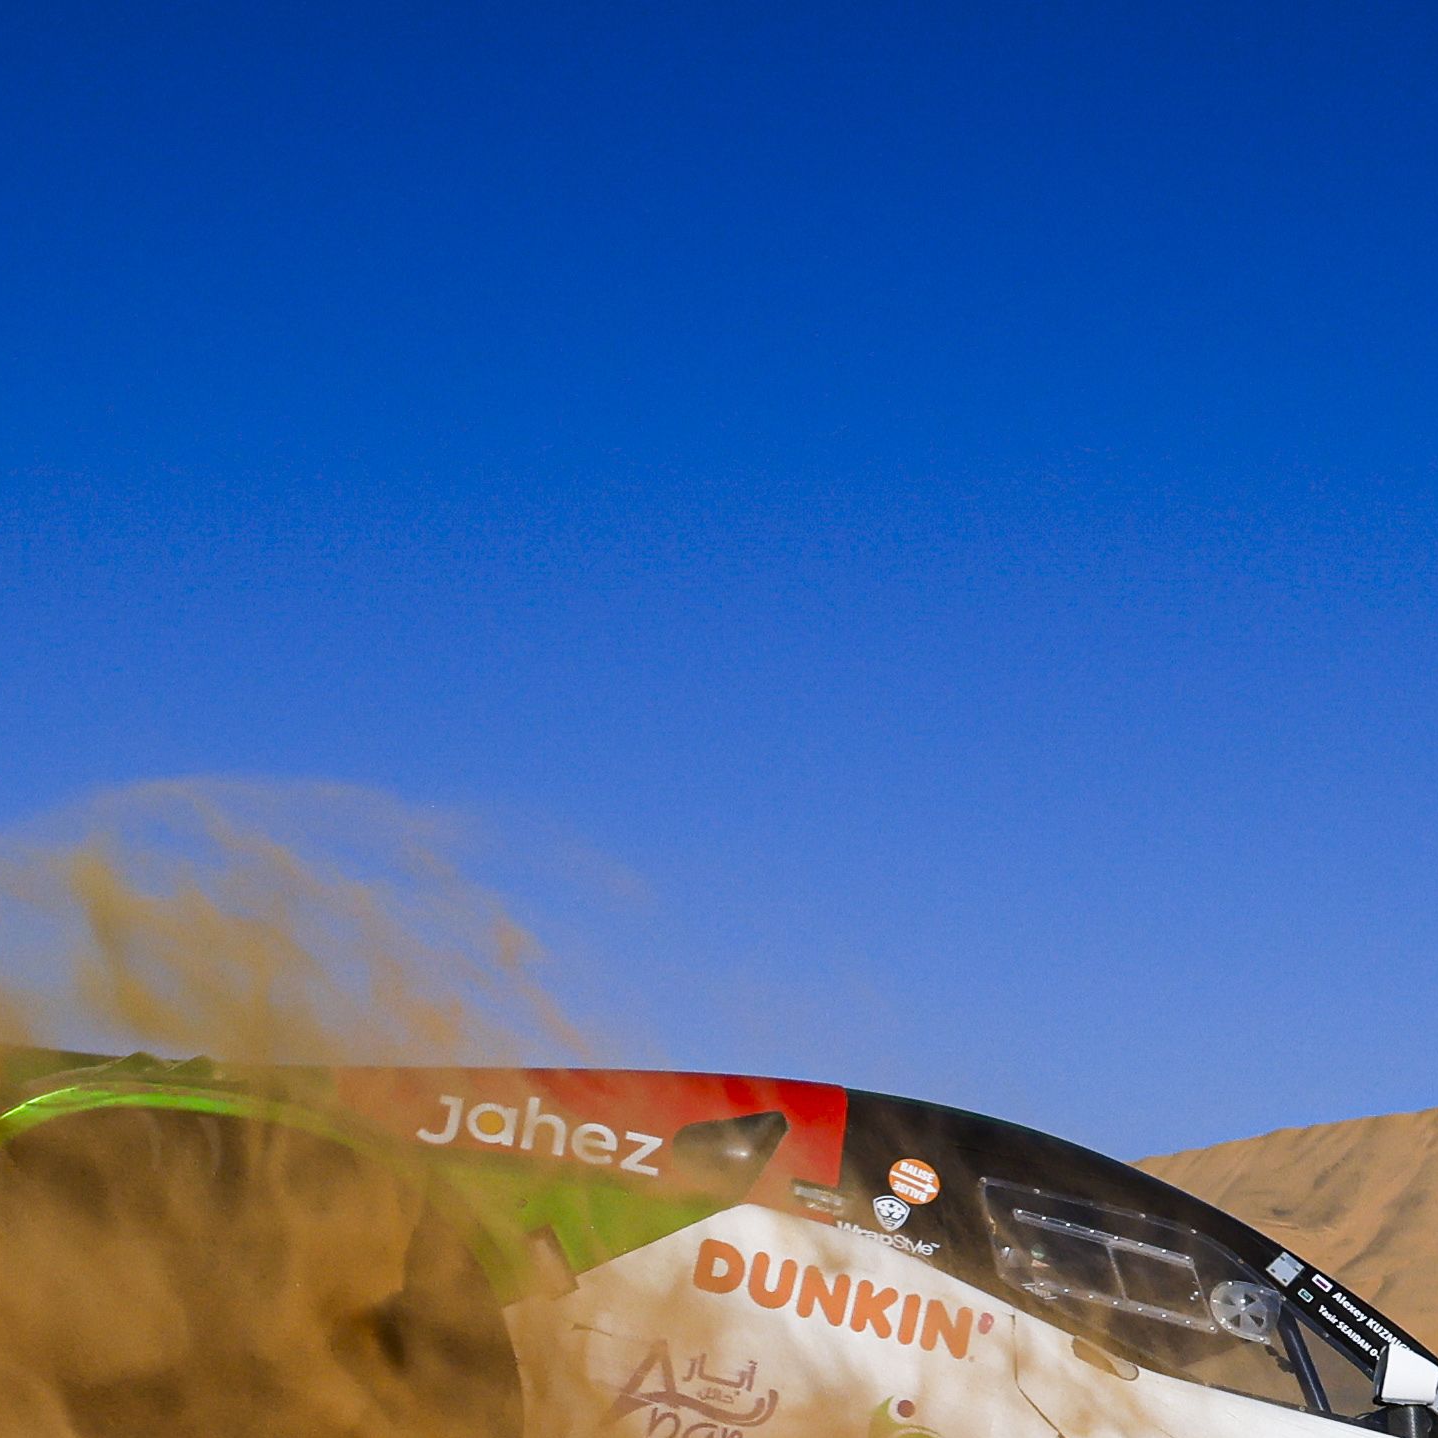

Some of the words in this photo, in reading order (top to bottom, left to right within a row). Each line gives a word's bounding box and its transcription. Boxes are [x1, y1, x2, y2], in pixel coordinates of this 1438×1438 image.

[899, 1161, 936, 1184] BALISE
[1318, 1304, 1338, 1325] Yasir
[1335, 1321, 1370, 1352] SEAIDAN
[1332, 1291, 1367, 1323] Alexey
[1365, 1317, 1411, 1354] KUZMI
